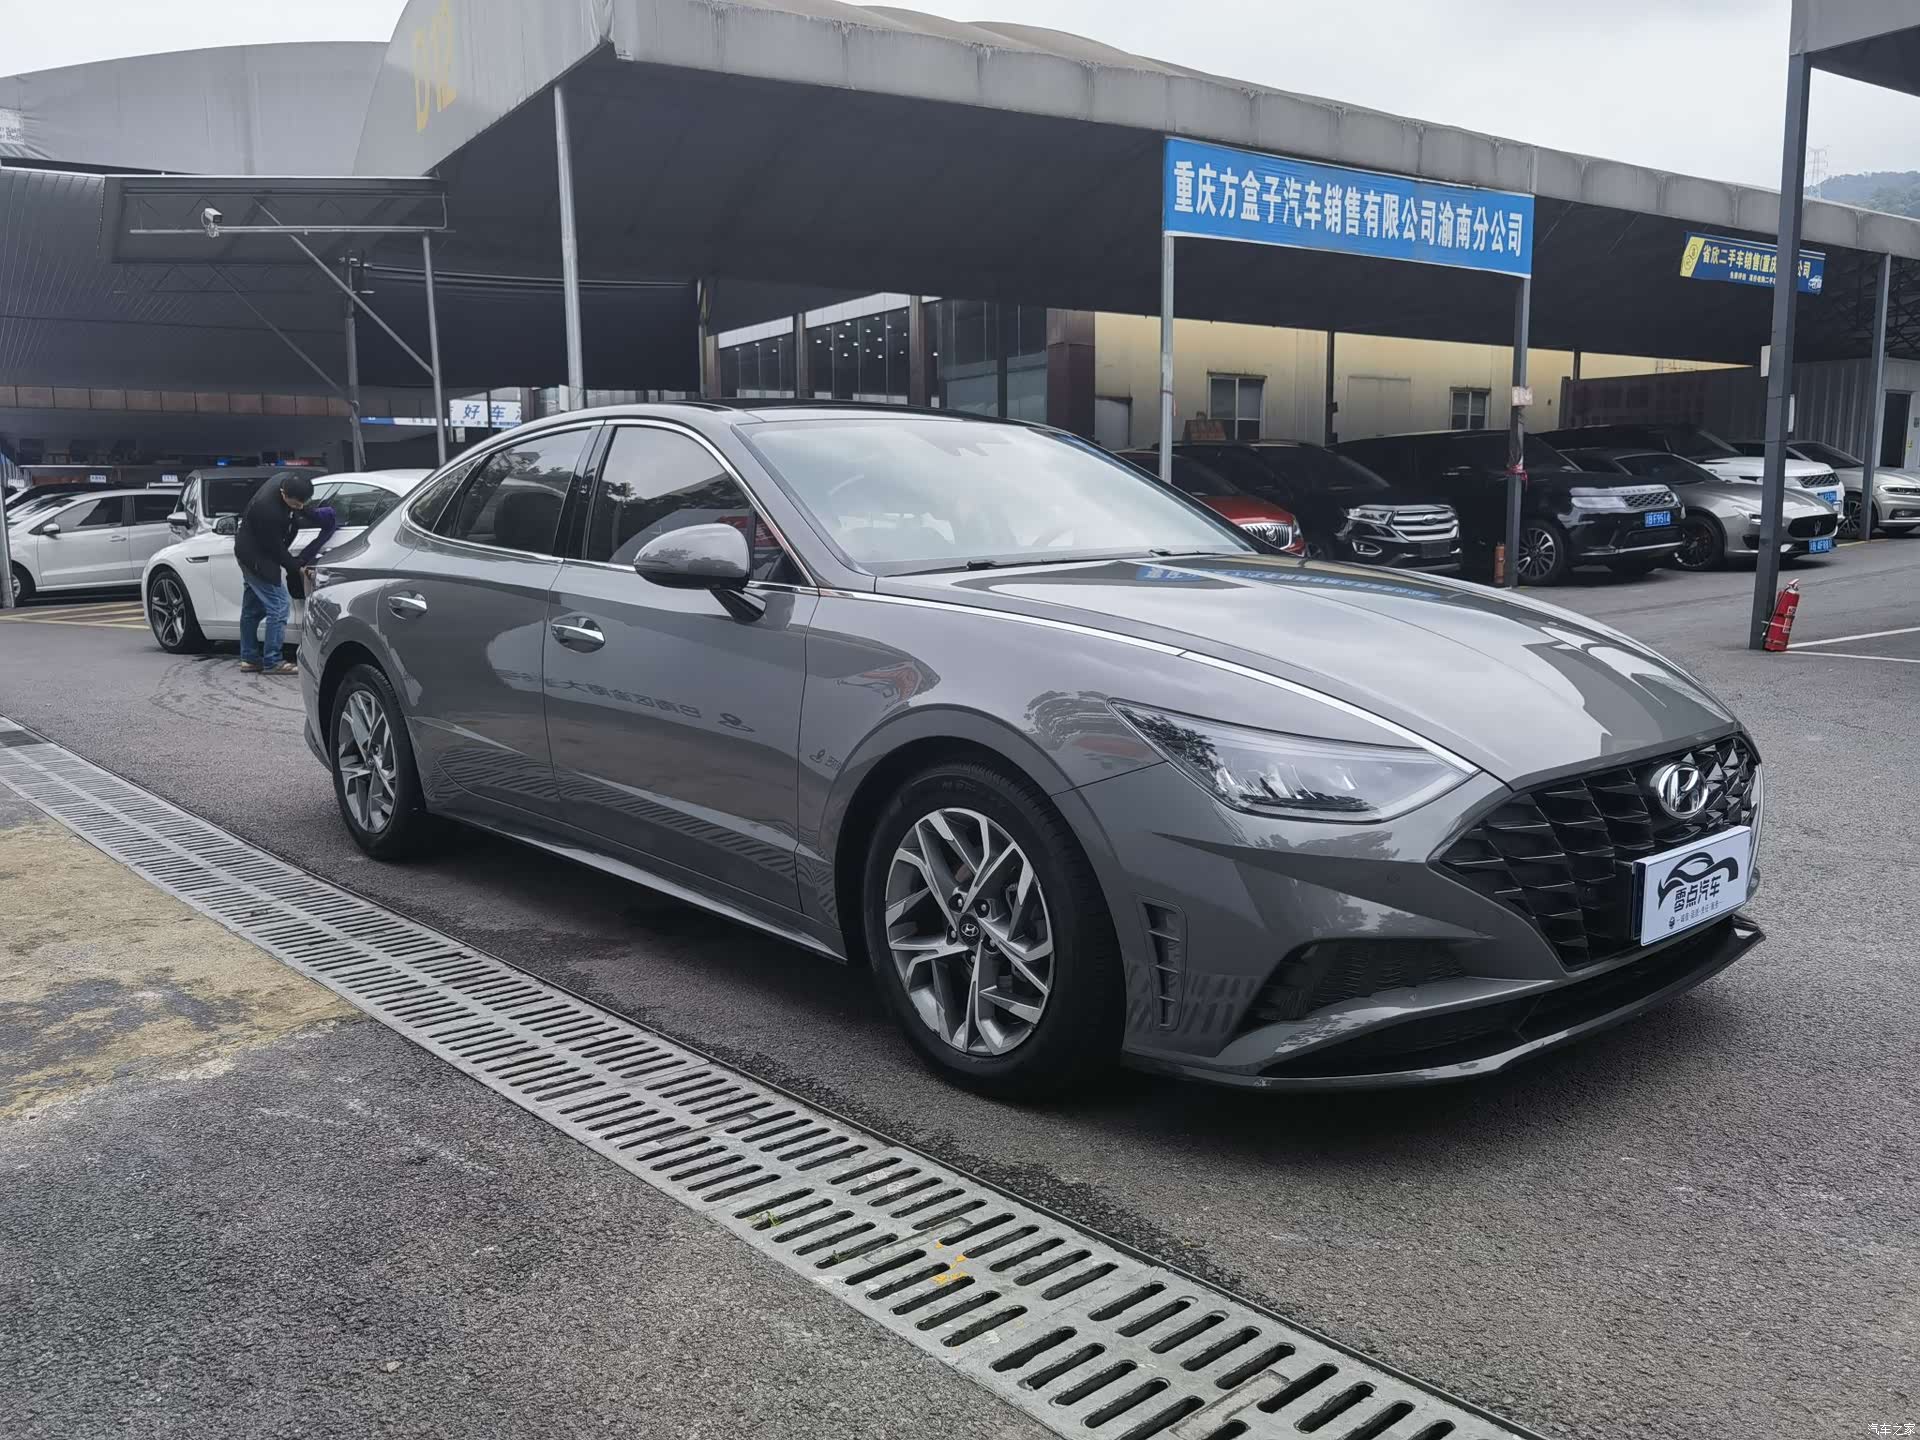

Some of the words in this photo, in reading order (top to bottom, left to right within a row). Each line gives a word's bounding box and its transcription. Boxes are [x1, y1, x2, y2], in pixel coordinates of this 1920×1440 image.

[1173, 160, 1523, 257] 重庆方盒子汽车销售有限公司渝南分公司
